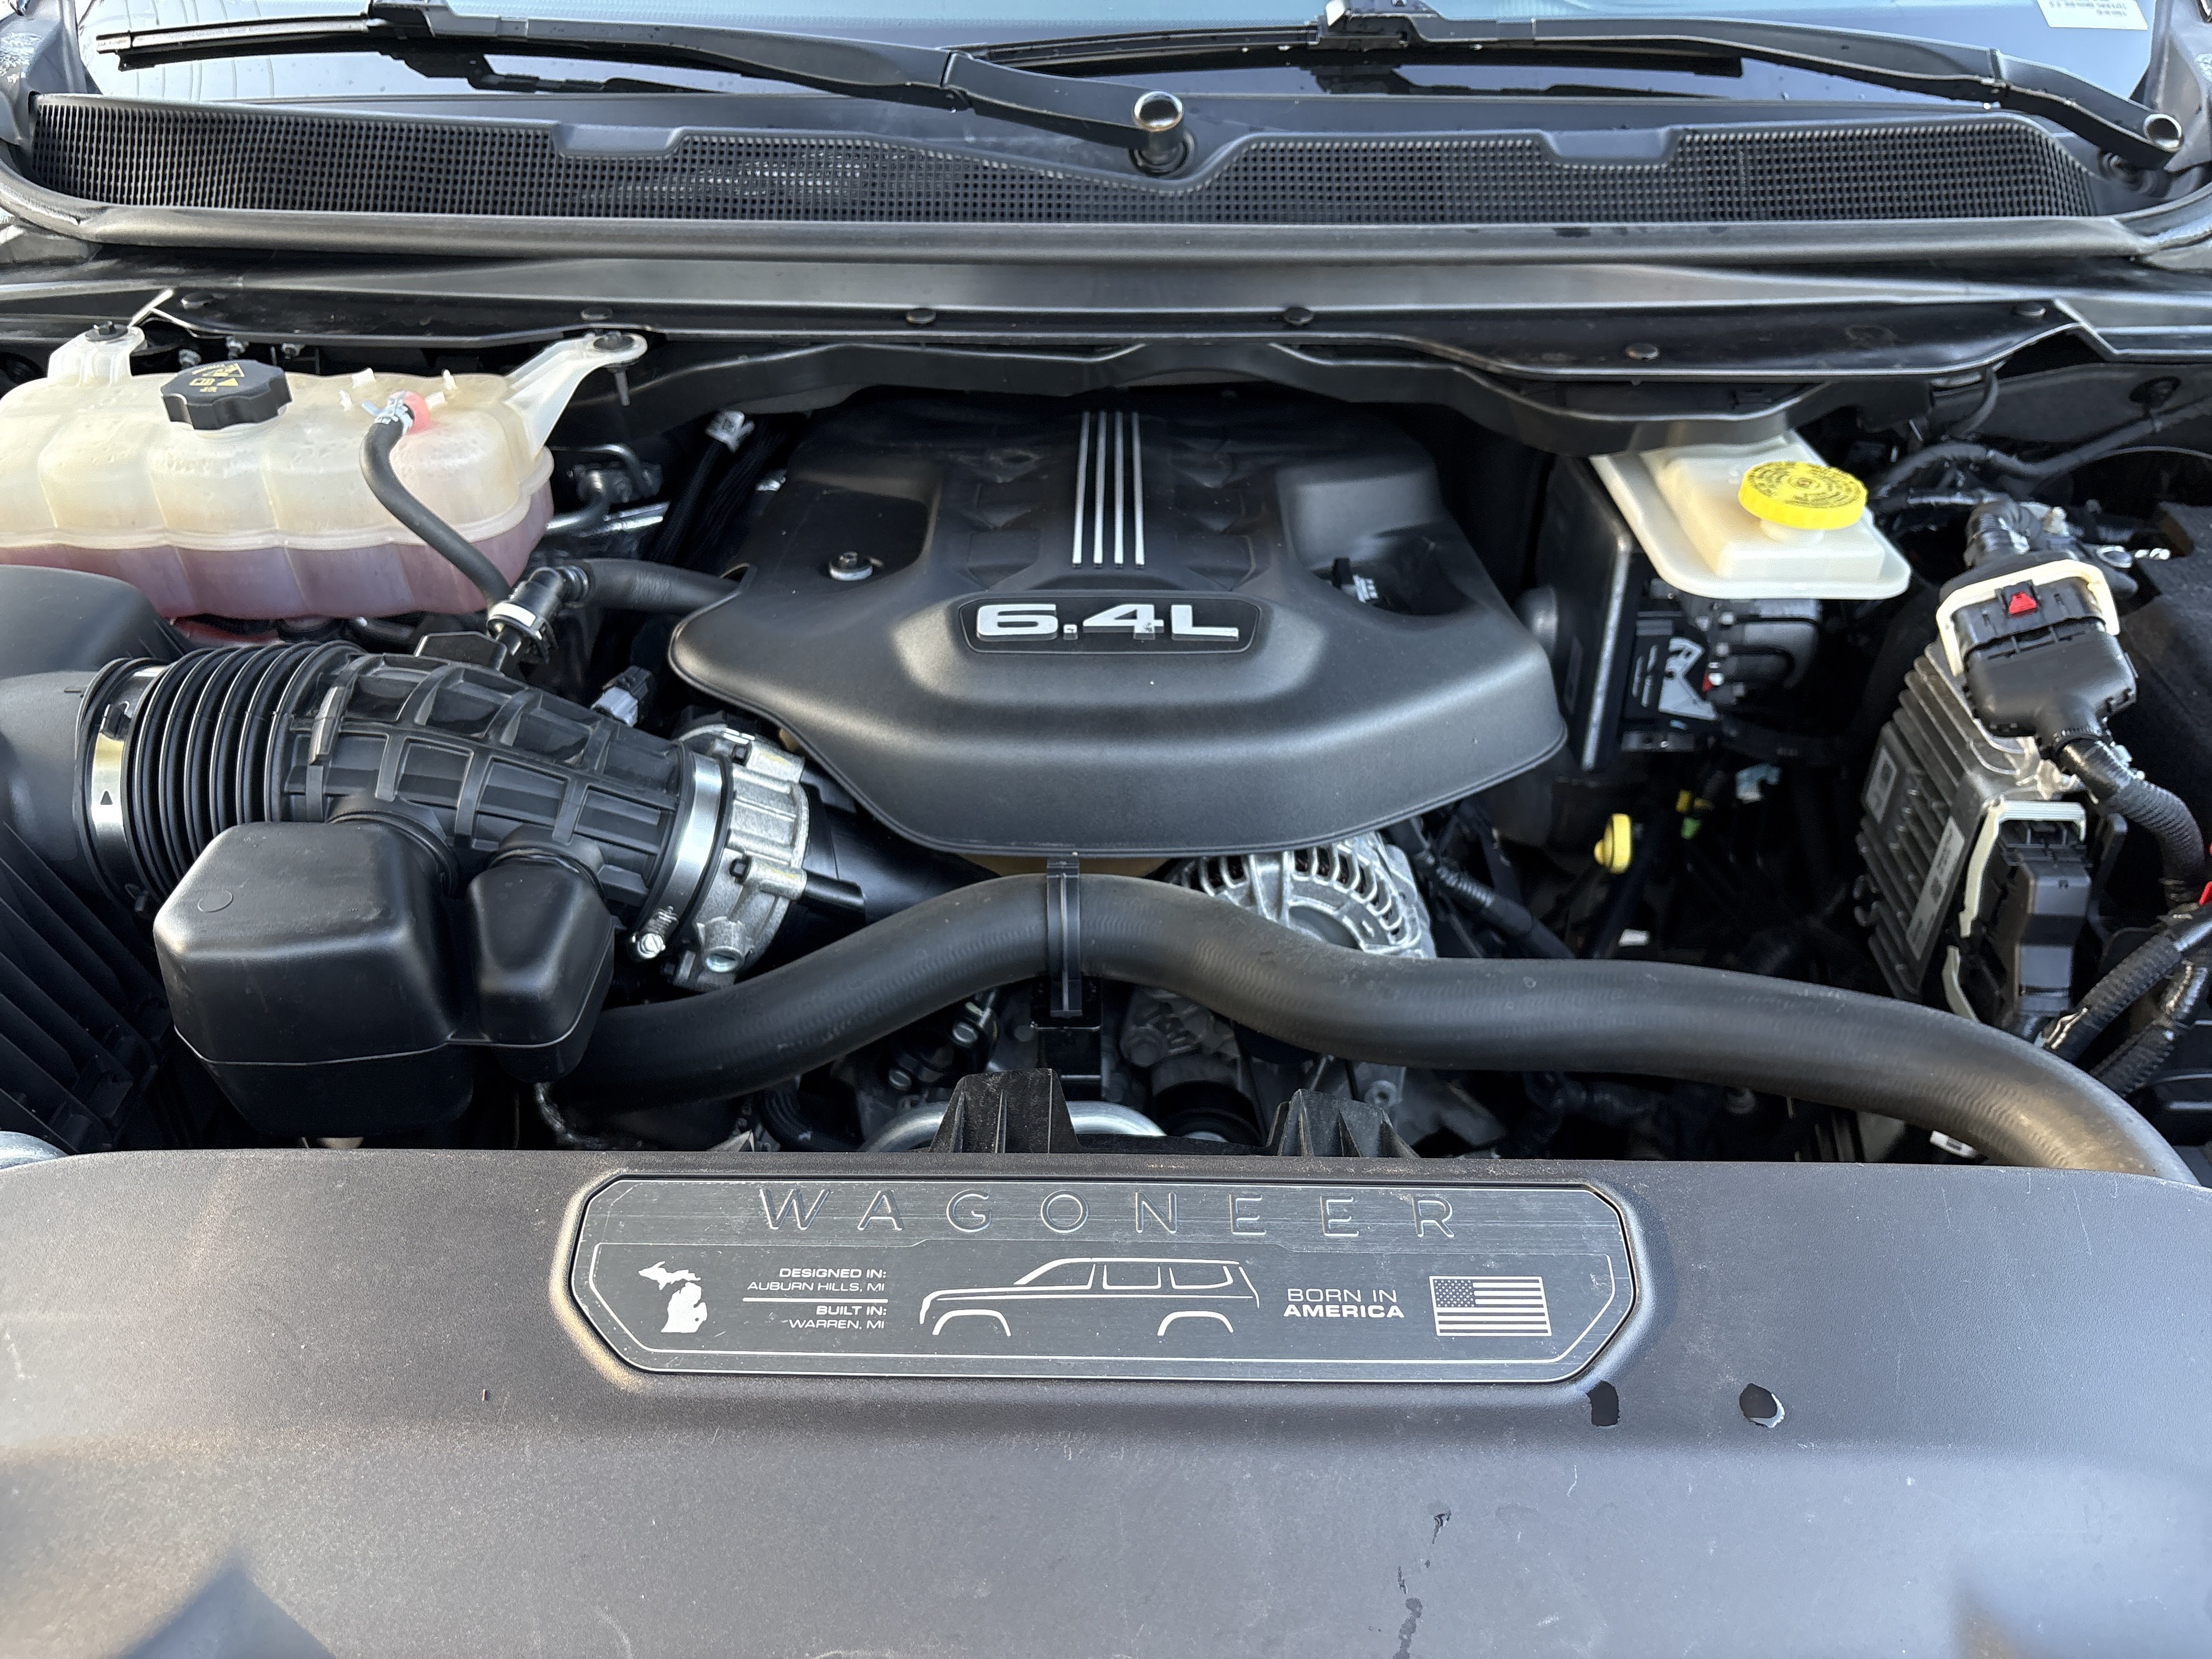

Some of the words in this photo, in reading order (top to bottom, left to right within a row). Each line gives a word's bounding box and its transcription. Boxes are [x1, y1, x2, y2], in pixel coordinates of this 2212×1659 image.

[976, 603, 1239, 641] 6.4L
[759, 1188, 1455, 1238] WAGONEER
[779, 1268, 862, 1278] DESIGNED
[866, 1269, 887, 1279] IN:
[747, 1282, 814, 1291] AUBURN
[867, 1283, 885, 1292] MI
[1287, 1288, 1362, 1303] BORN
[1373, 1289, 1397, 1304] IN
[816, 1305, 862, 1316] BUILT
[866, 1306, 887, 1316] IN:
[1283, 1304, 1406, 1318] AMERICA
[866, 1320, 885, 1329] MI
